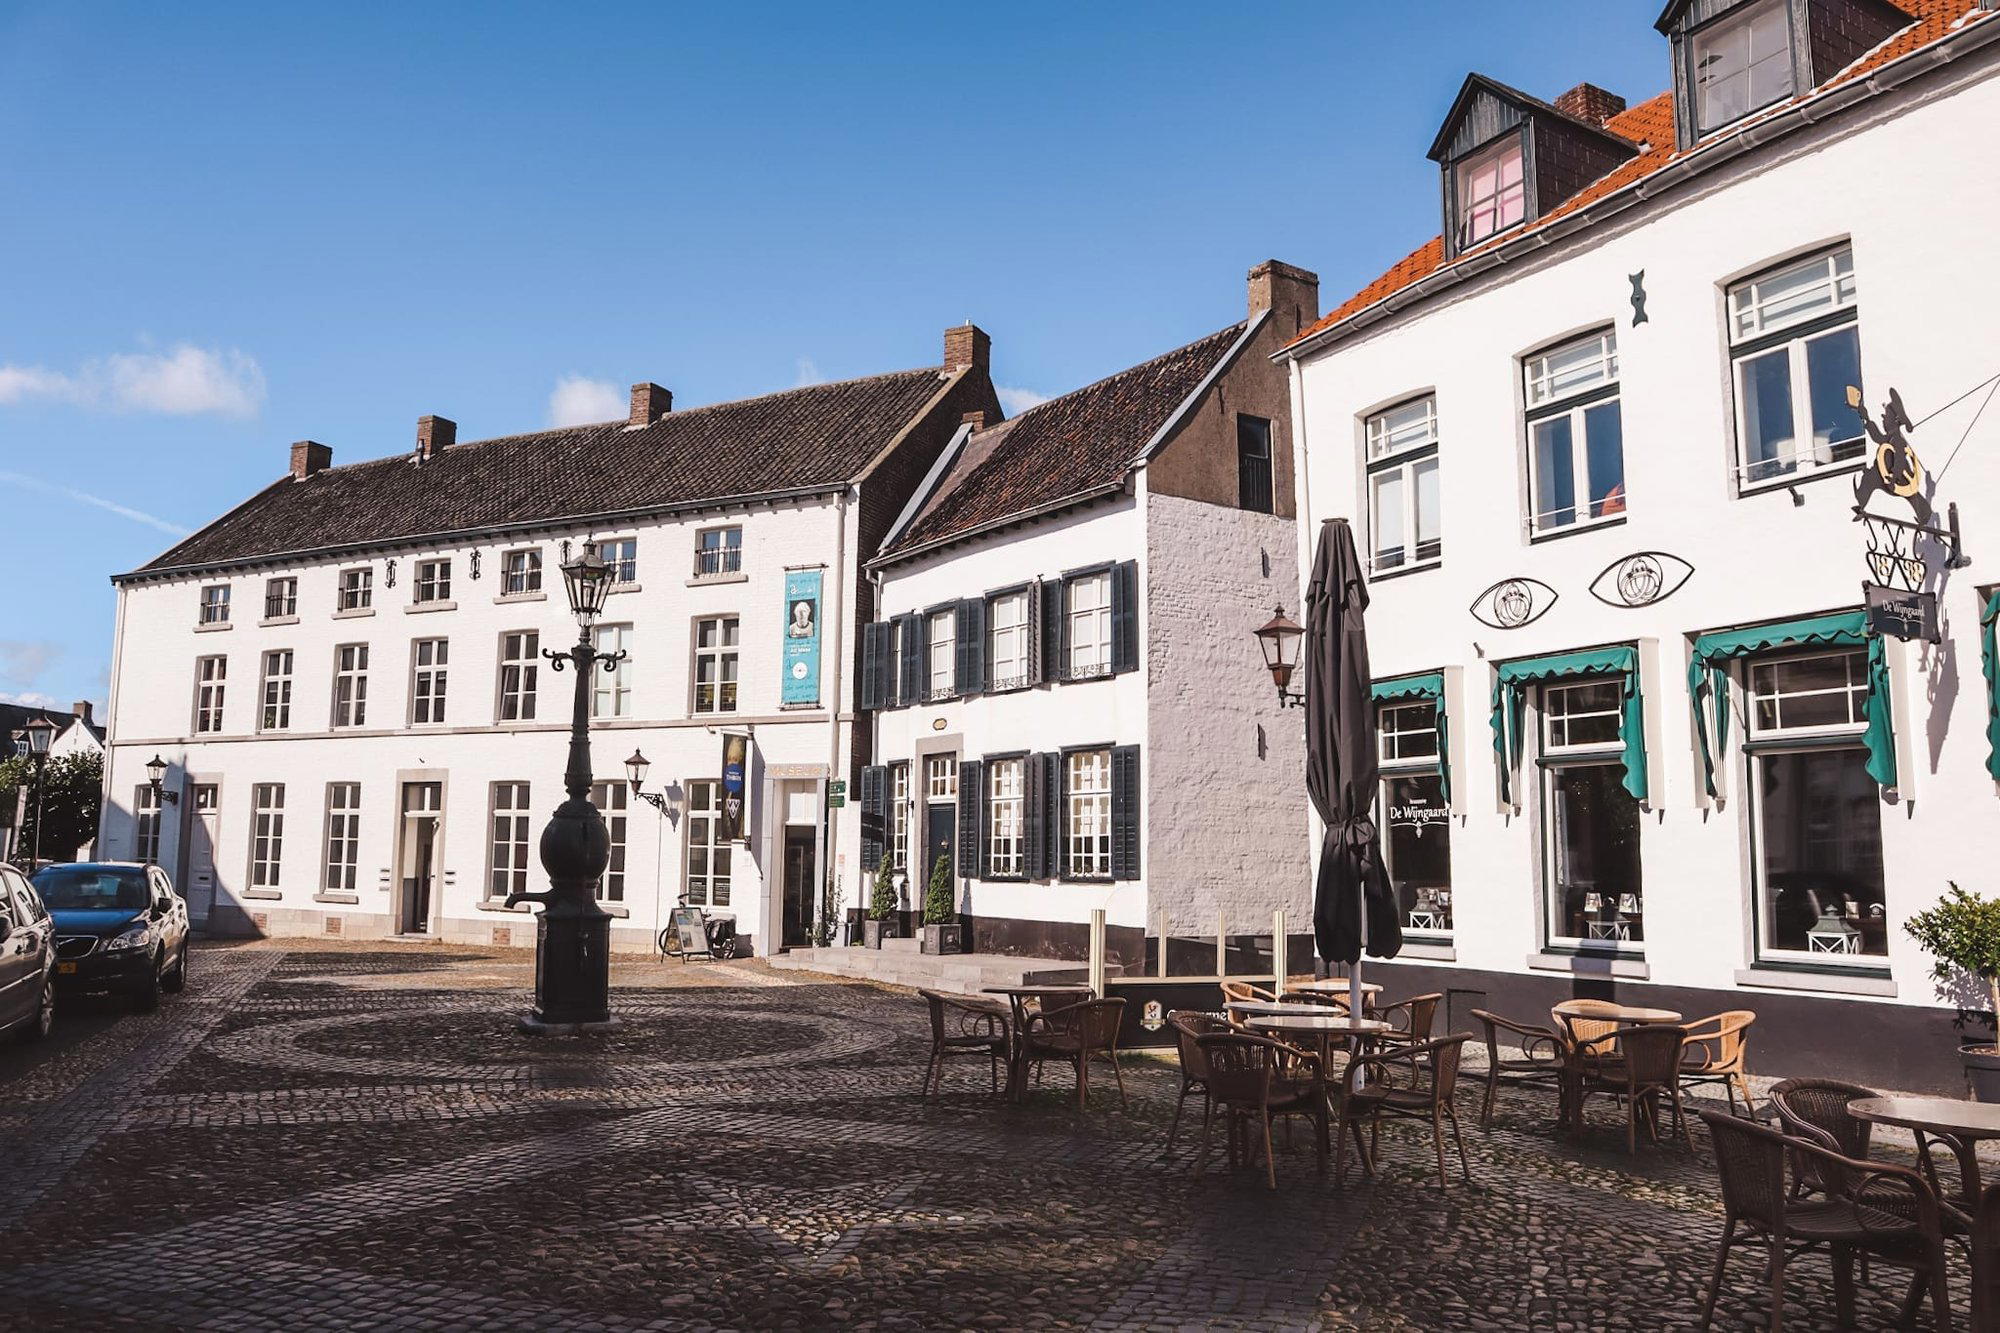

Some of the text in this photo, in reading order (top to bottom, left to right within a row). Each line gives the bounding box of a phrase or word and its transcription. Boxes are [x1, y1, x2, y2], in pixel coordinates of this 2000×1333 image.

[1883, 600, 1925, 618] De Wijngaard
[1390, 806, 1448, 822] De Wijngaard
